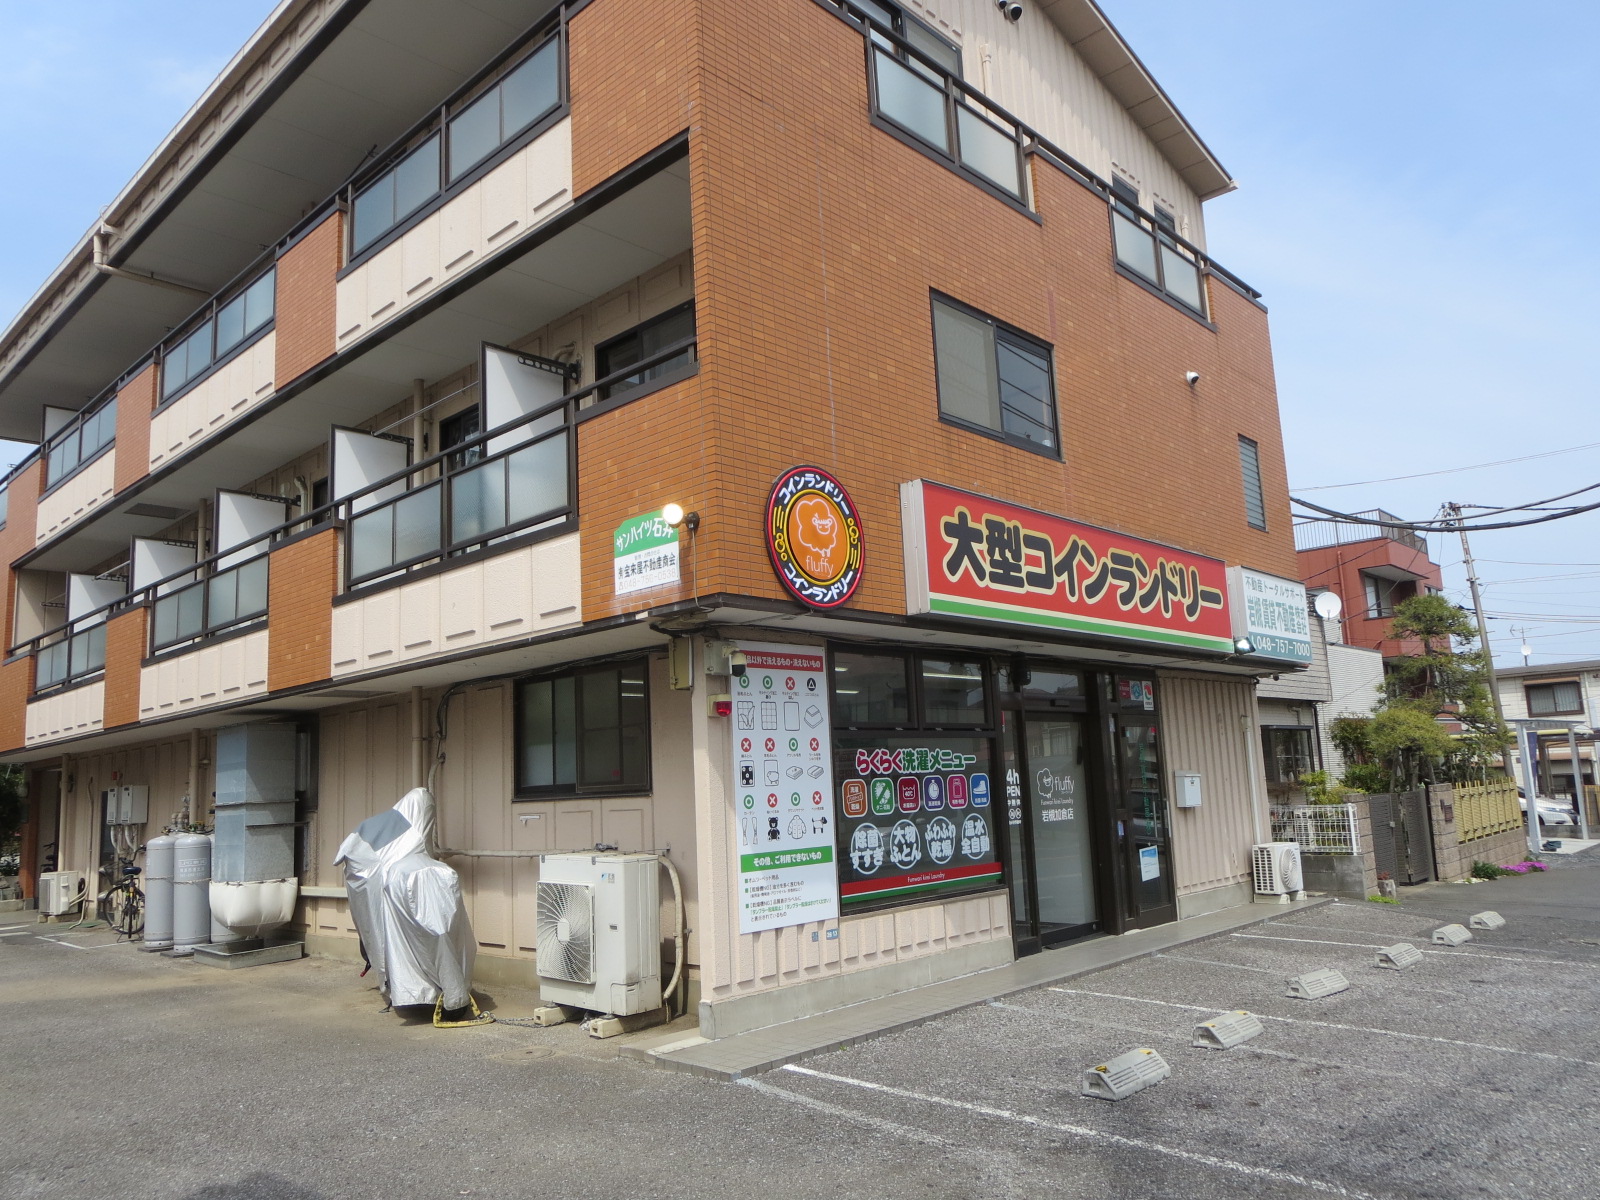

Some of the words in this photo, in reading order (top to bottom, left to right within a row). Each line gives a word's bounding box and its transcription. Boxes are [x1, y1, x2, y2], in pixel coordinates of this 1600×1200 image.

[779, 473, 849, 514] コインランドリー
[616, 517, 674, 552] サンハイツ石井
[806, 555, 834, 577] fluffy
[940, 505, 1224, 621] 大型コインランドリー
[784, 571, 853, 602] コインランドリー
[1244, 575, 1304, 601] 不動産トータルサポート
[1256, 636, 1311, 656] 048-757-7000
[856, 748, 977, 775] らくらく洗濯メニュー
[1006, 768, 1020, 785] 4h
[1055, 775, 1075, 794] fluffy
[1006, 785, 1021, 797] PEN
[893, 825, 917, 844] 大物
[924, 822, 956, 841] ふわふわ
[965, 819, 985, 837] 温水
[854, 829, 879, 849] 除菌
[930, 839, 953, 859] 乾燥
[961, 835, 990, 854] 全自動
[850, 846, 885, 869] すすぎ
[890, 843, 921, 863] ふとん
